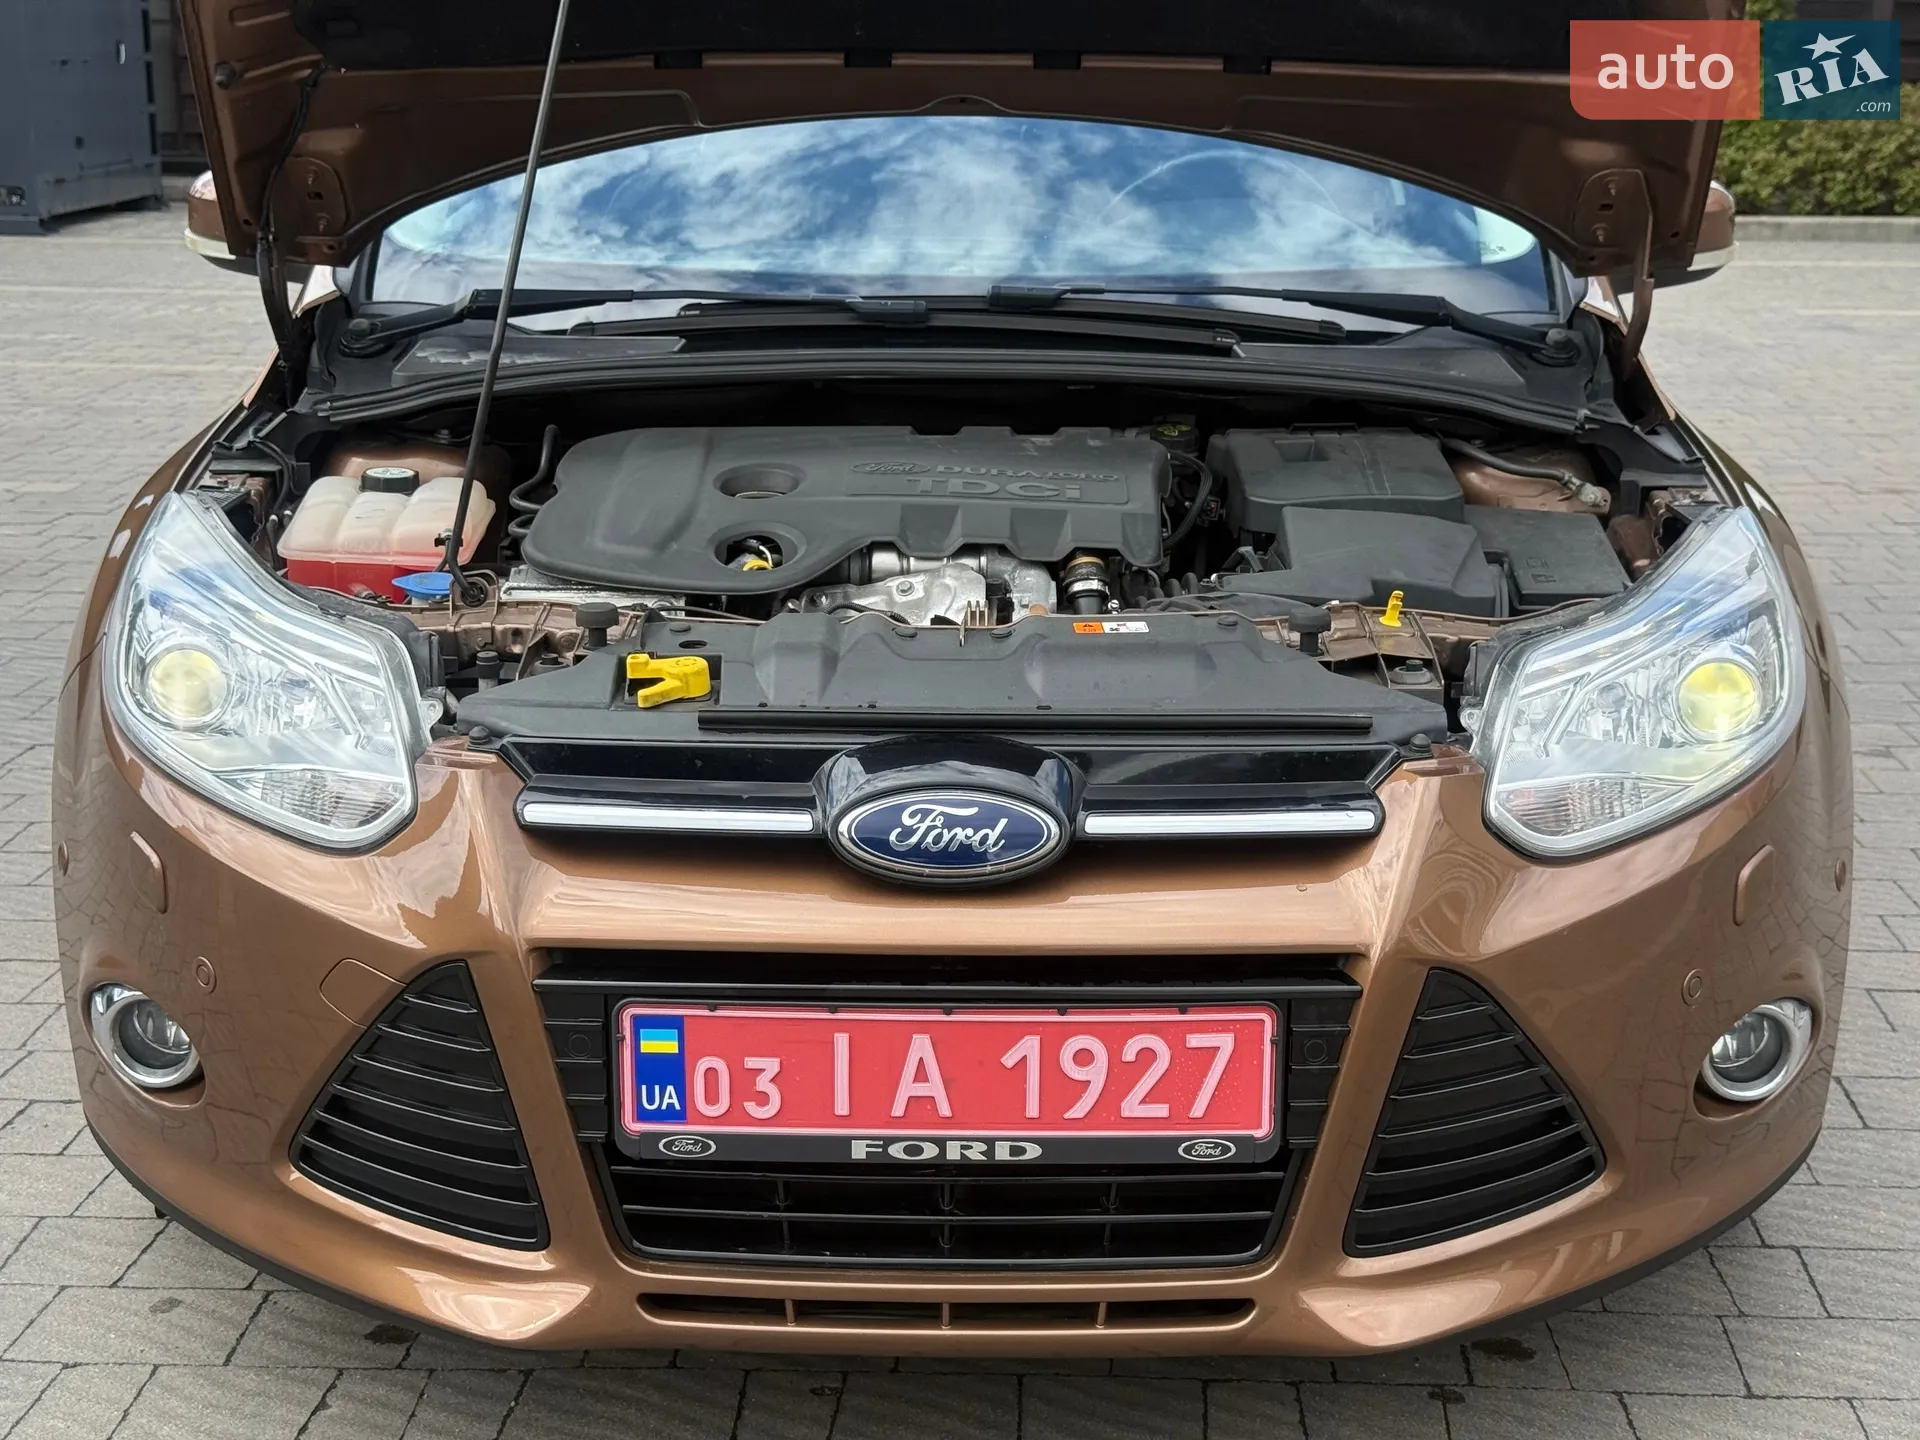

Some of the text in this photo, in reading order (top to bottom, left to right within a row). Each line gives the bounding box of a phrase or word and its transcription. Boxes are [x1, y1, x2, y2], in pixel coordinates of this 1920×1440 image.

[906, 477, 1081, 500] TDCi
[888, 803, 1009, 852] Ford
[693, 1056, 783, 1120] 03
[1000, 1033, 1235, 1119] 1927
[641, 1084, 681, 1111] UA
[671, 1138, 703, 1154] Ford
[851, 1139, 1043, 1161] FORD
[1190, 1142, 1222, 1157] Ford
